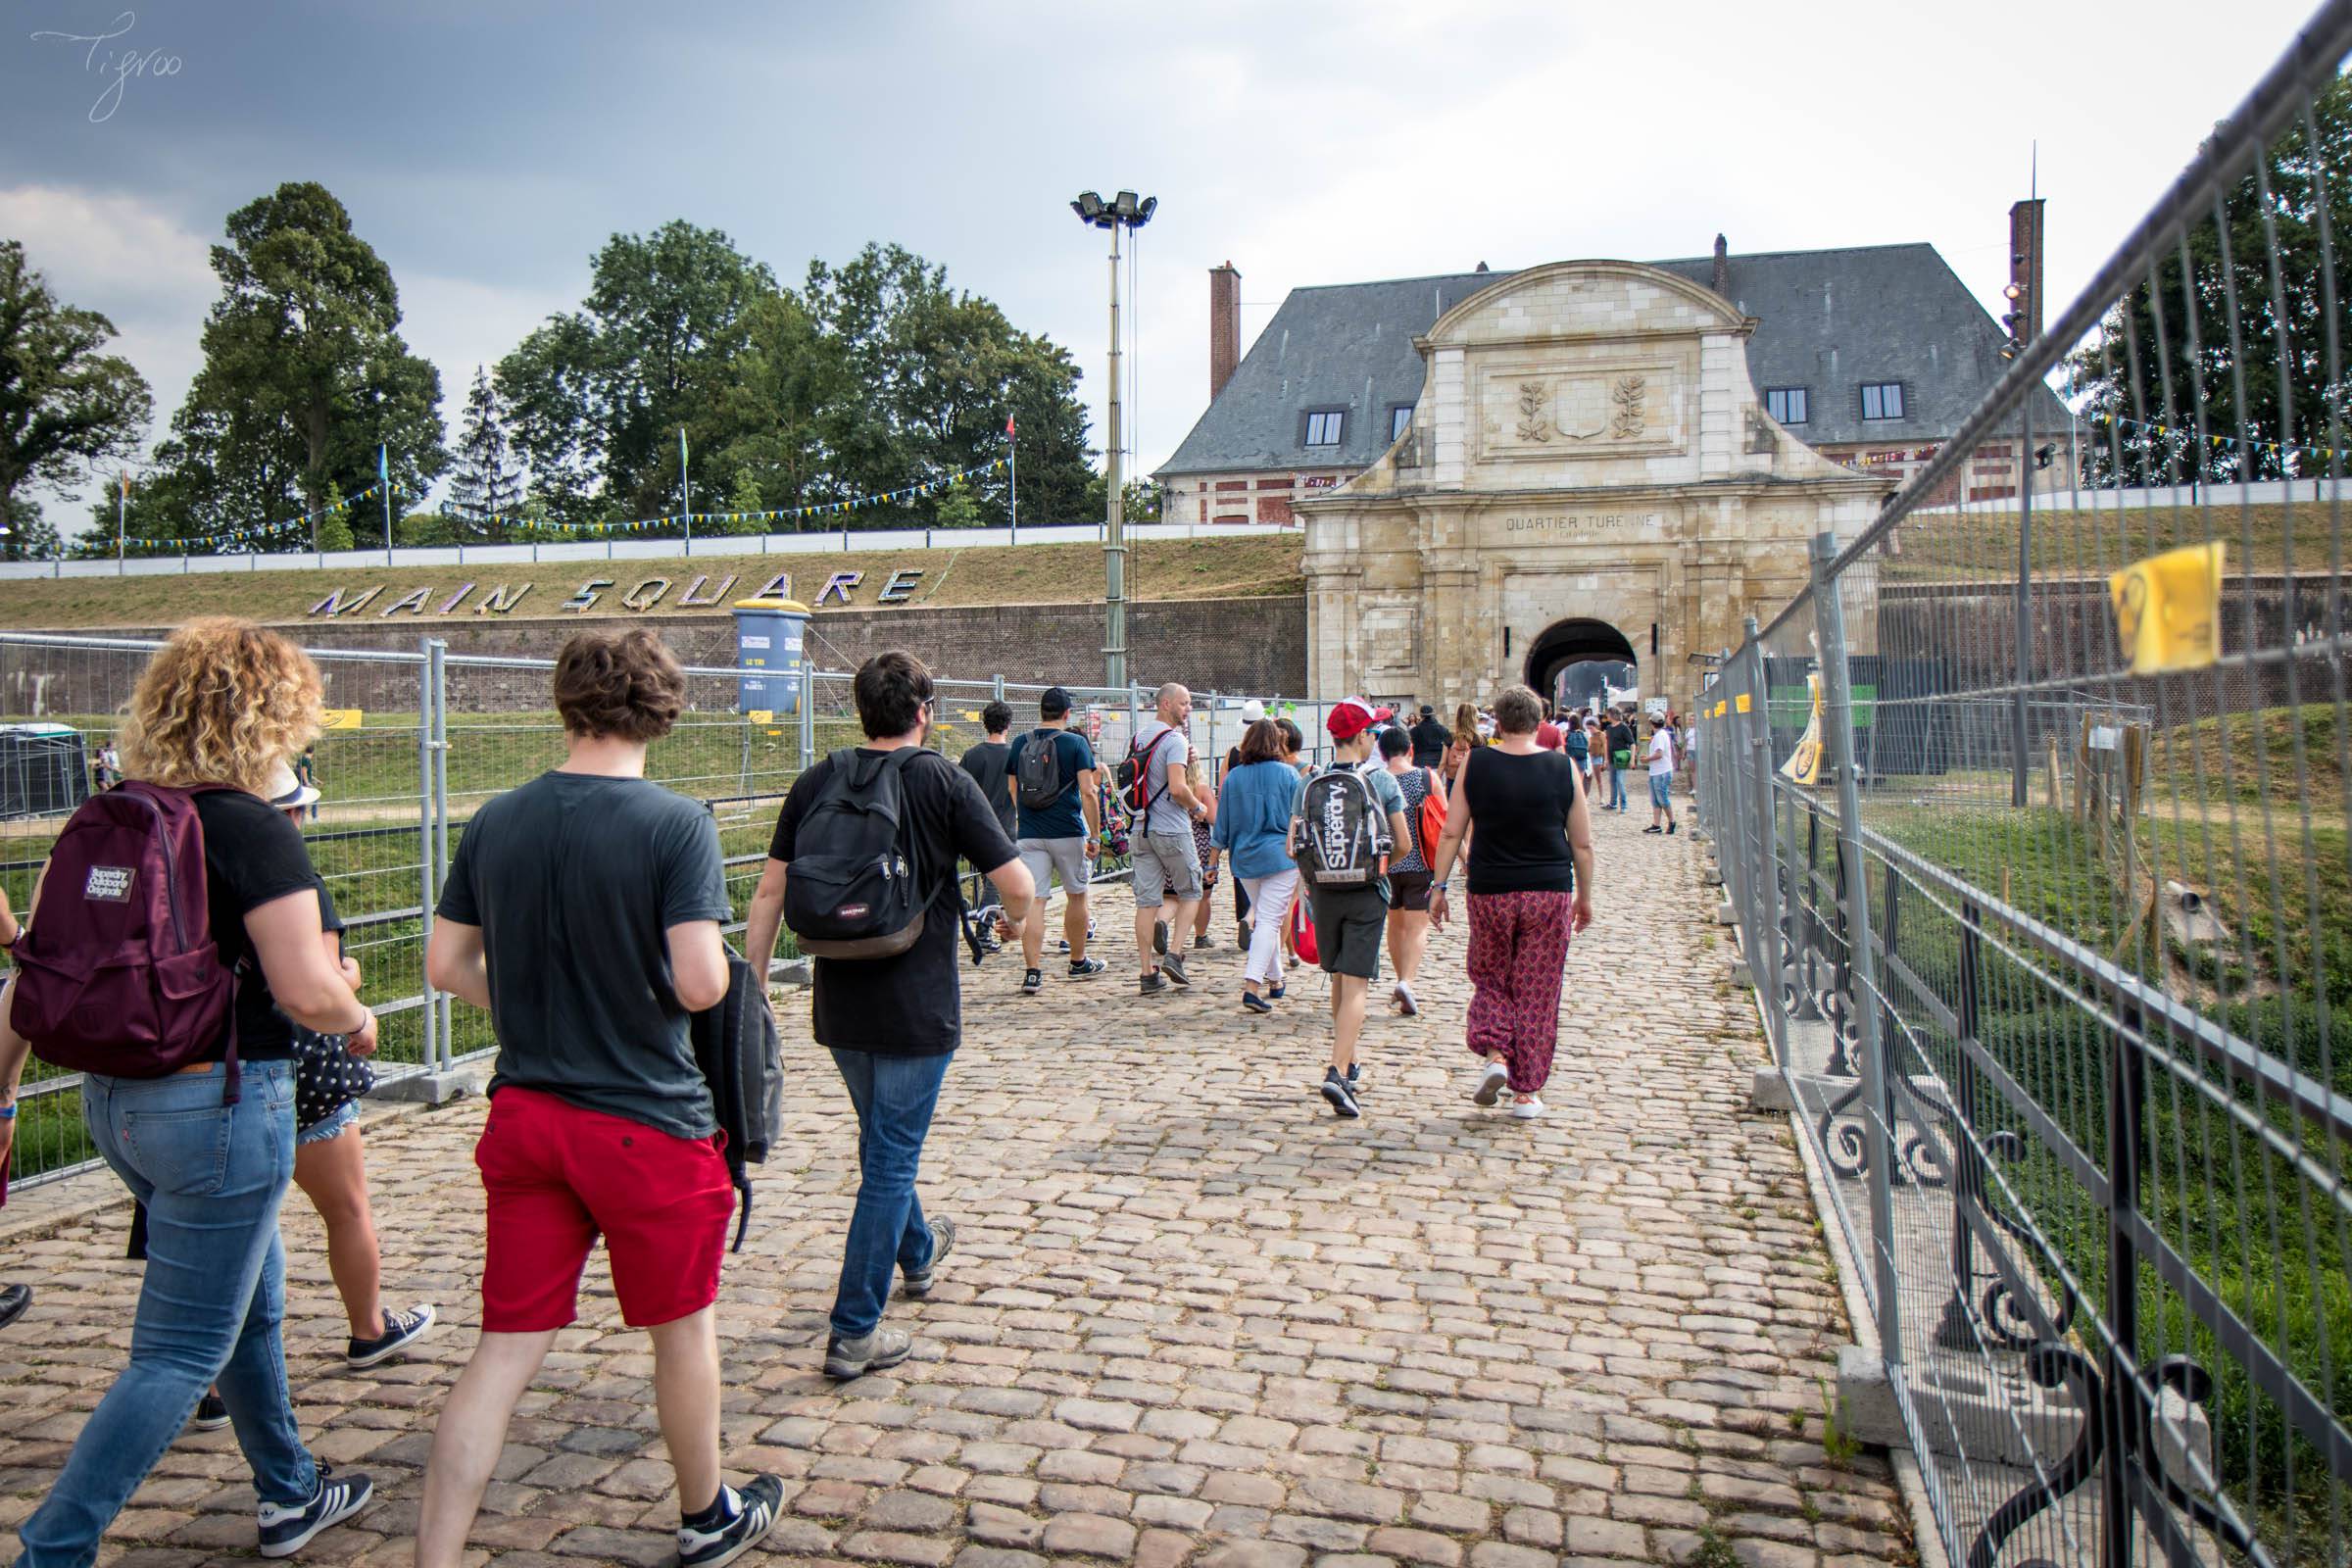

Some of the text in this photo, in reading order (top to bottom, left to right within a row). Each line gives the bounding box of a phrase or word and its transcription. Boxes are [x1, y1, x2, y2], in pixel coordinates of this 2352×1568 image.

[1505, 516, 1578, 531] QUARTIER
[308, 568, 924, 617] MAIN SQUARE
